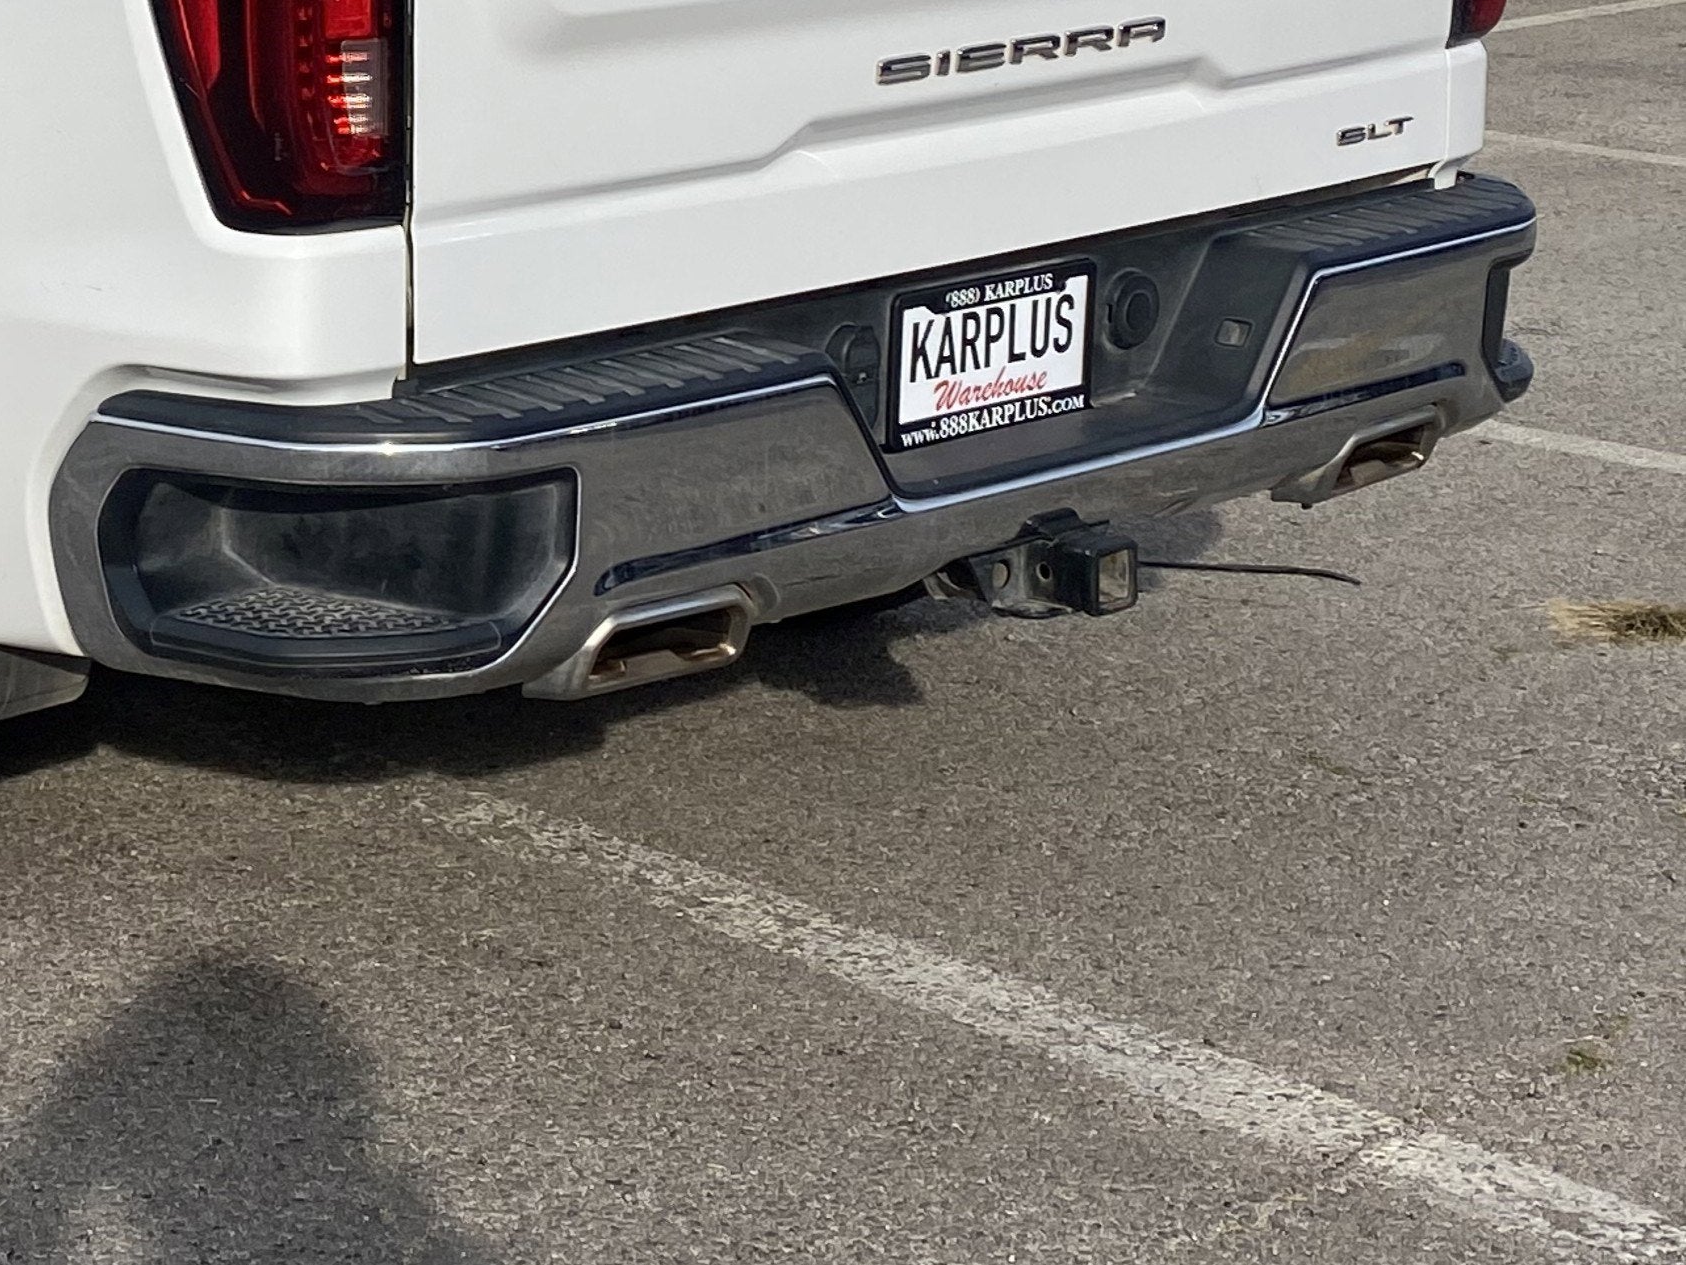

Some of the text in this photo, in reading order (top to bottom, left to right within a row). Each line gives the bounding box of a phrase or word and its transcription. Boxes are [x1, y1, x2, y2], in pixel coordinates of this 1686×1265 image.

[876, 16, 1166, 85] SIERRA
[1336, 114, 1414, 146] SLT
[945, 273, 1053, 308] (888) KARPLUS
[910, 294, 1075, 383] KARPLUS
[934, 366, 1047, 412] Warehouse
